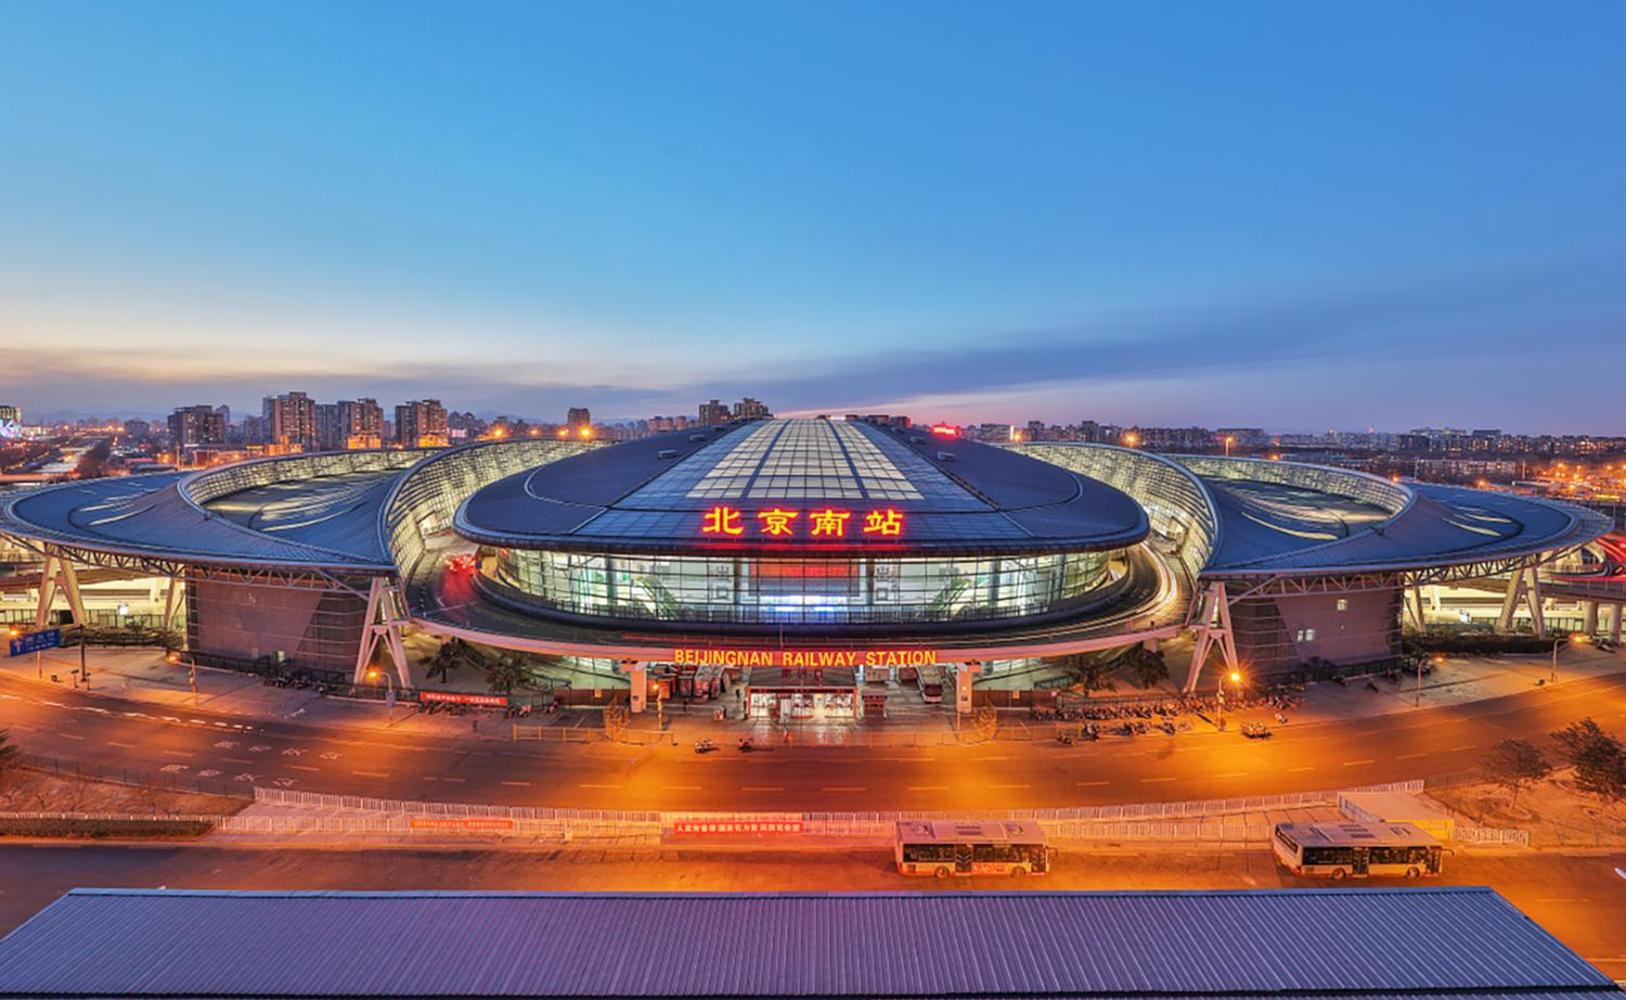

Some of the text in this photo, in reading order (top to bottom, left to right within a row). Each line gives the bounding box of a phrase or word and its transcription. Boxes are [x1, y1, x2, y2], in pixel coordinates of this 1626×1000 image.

[702, 507, 903, 536] 北京南站
[674, 650, 936, 667] BEIJINGNAN RAILWAY STATION
